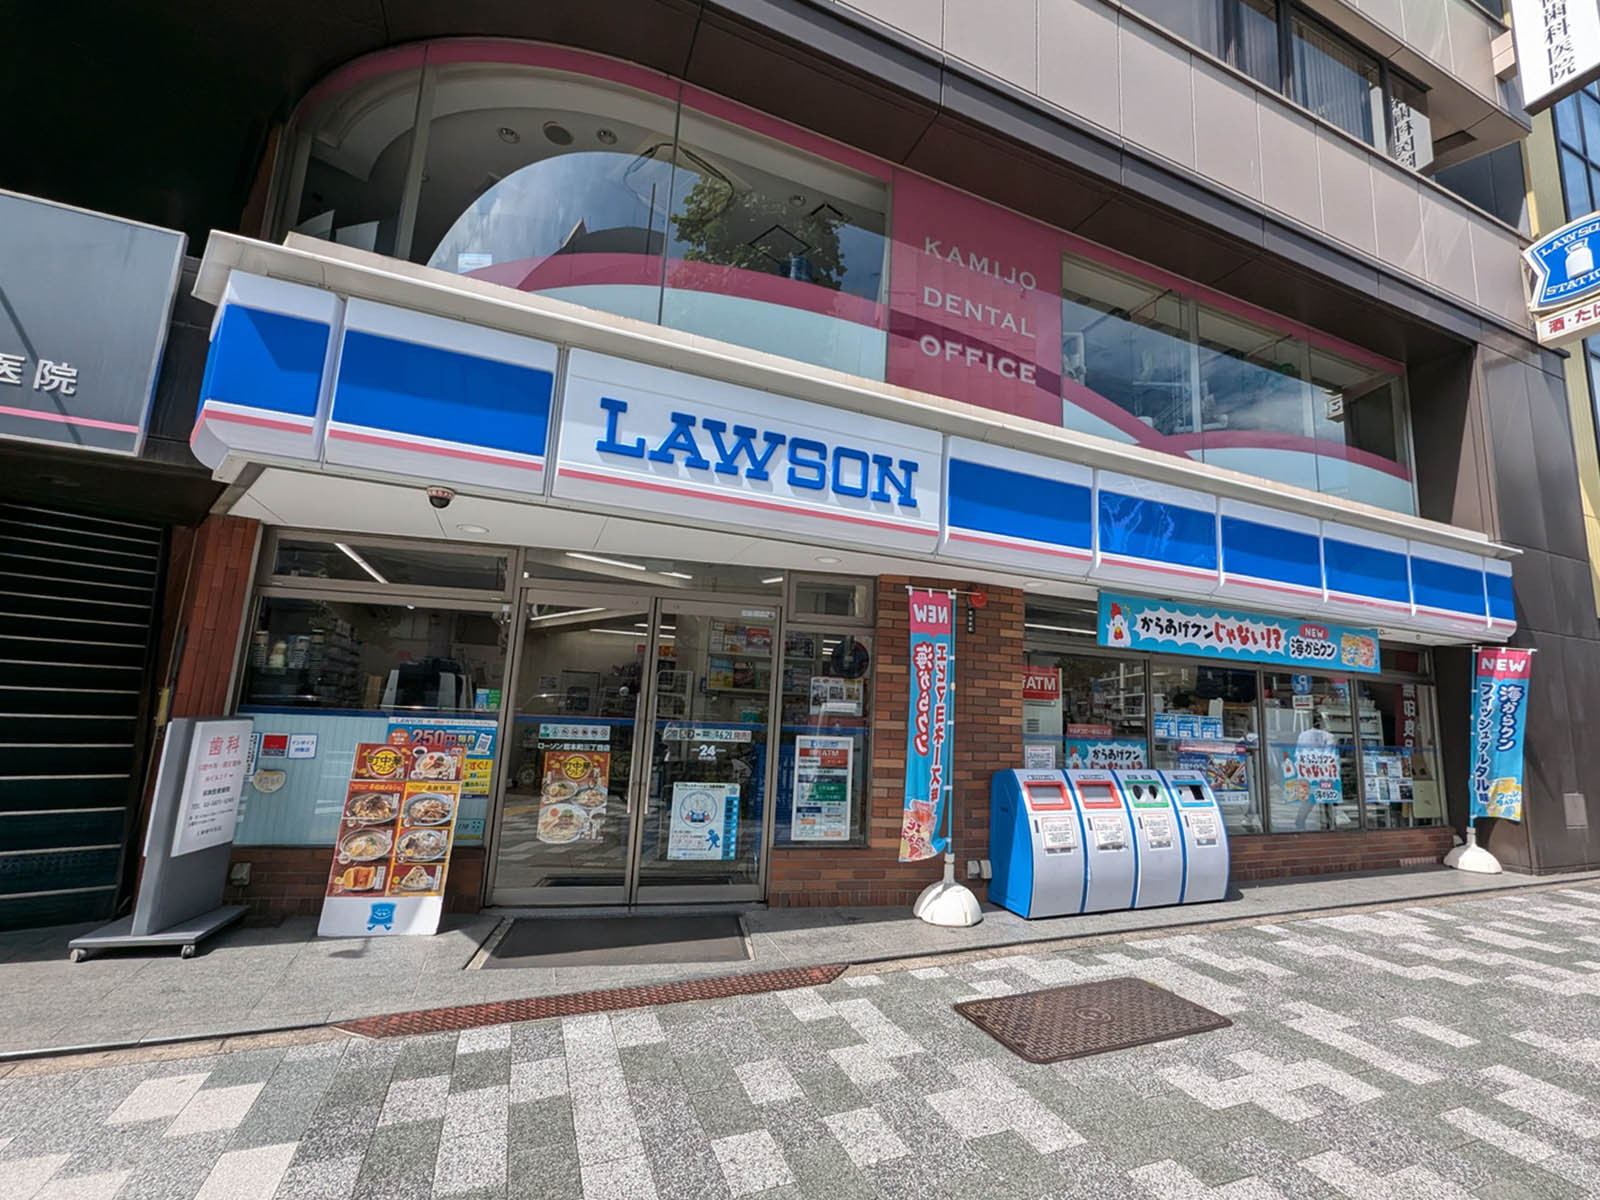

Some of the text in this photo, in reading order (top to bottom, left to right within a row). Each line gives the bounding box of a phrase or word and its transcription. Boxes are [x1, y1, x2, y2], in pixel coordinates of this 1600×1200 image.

[1543, 0, 1576, 85] 歯科医院
[924, 236, 1038, 291] KAMIJO
[923, 286, 1036, 339] DENTAL
[919, 334, 1038, 386] OFFICE
[596, 397, 919, 508] LAWSON
[1291, 638, 1336, 658] 海からクン
[1304, 628, 1324, 639] NEW
[1481, 658, 1526, 673] NEW
[1497, 685, 1524, 752] 海からクン
[209, 735, 240, 756] 歯科
[699, 744, 716, 757] 24
[1092, 748, 1141, 761] からあげクン
